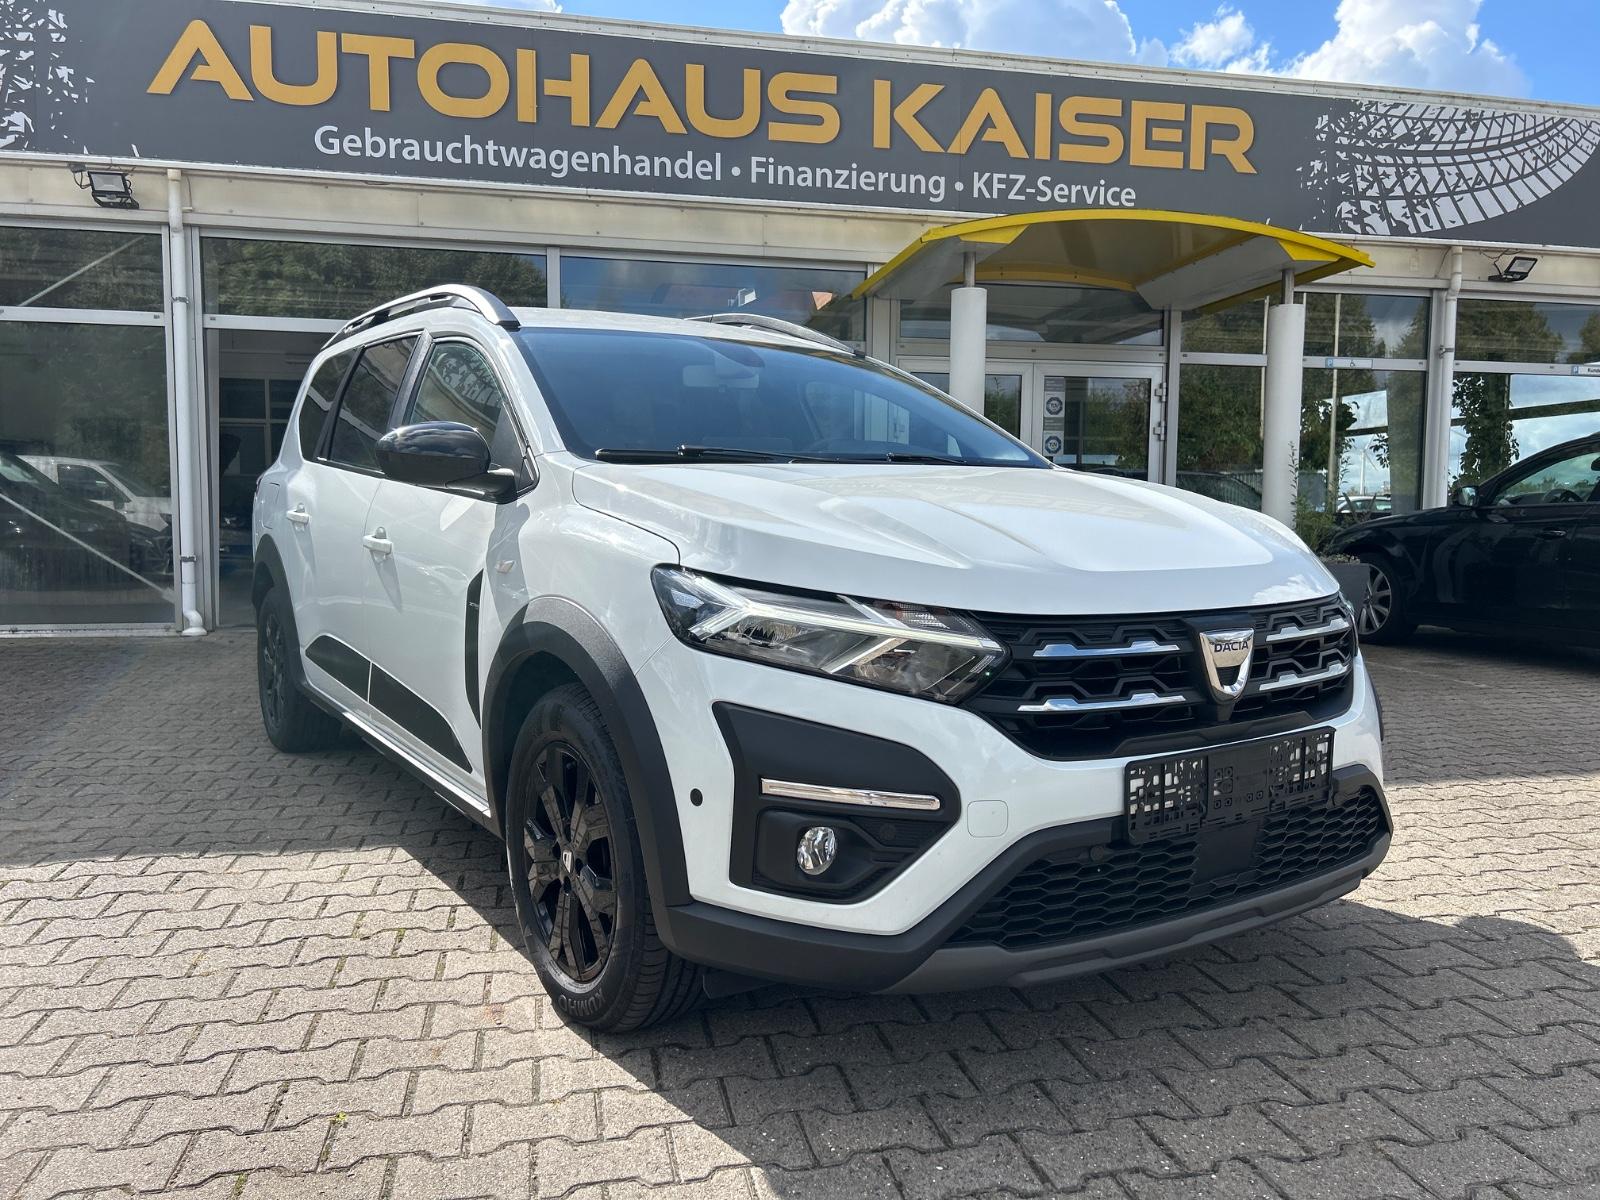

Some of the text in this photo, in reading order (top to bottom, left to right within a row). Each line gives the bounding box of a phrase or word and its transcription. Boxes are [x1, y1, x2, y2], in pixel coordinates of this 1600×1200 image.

[147, 19, 1257, 174] AUTOHAUS KAISER
[313, 125, 1137, 208] Gebrauchtwagenhandel Finanzierung KFZ-Service
[1214, 640, 1249, 652] DACIA
[558, 988, 606, 1017] KUMHO
